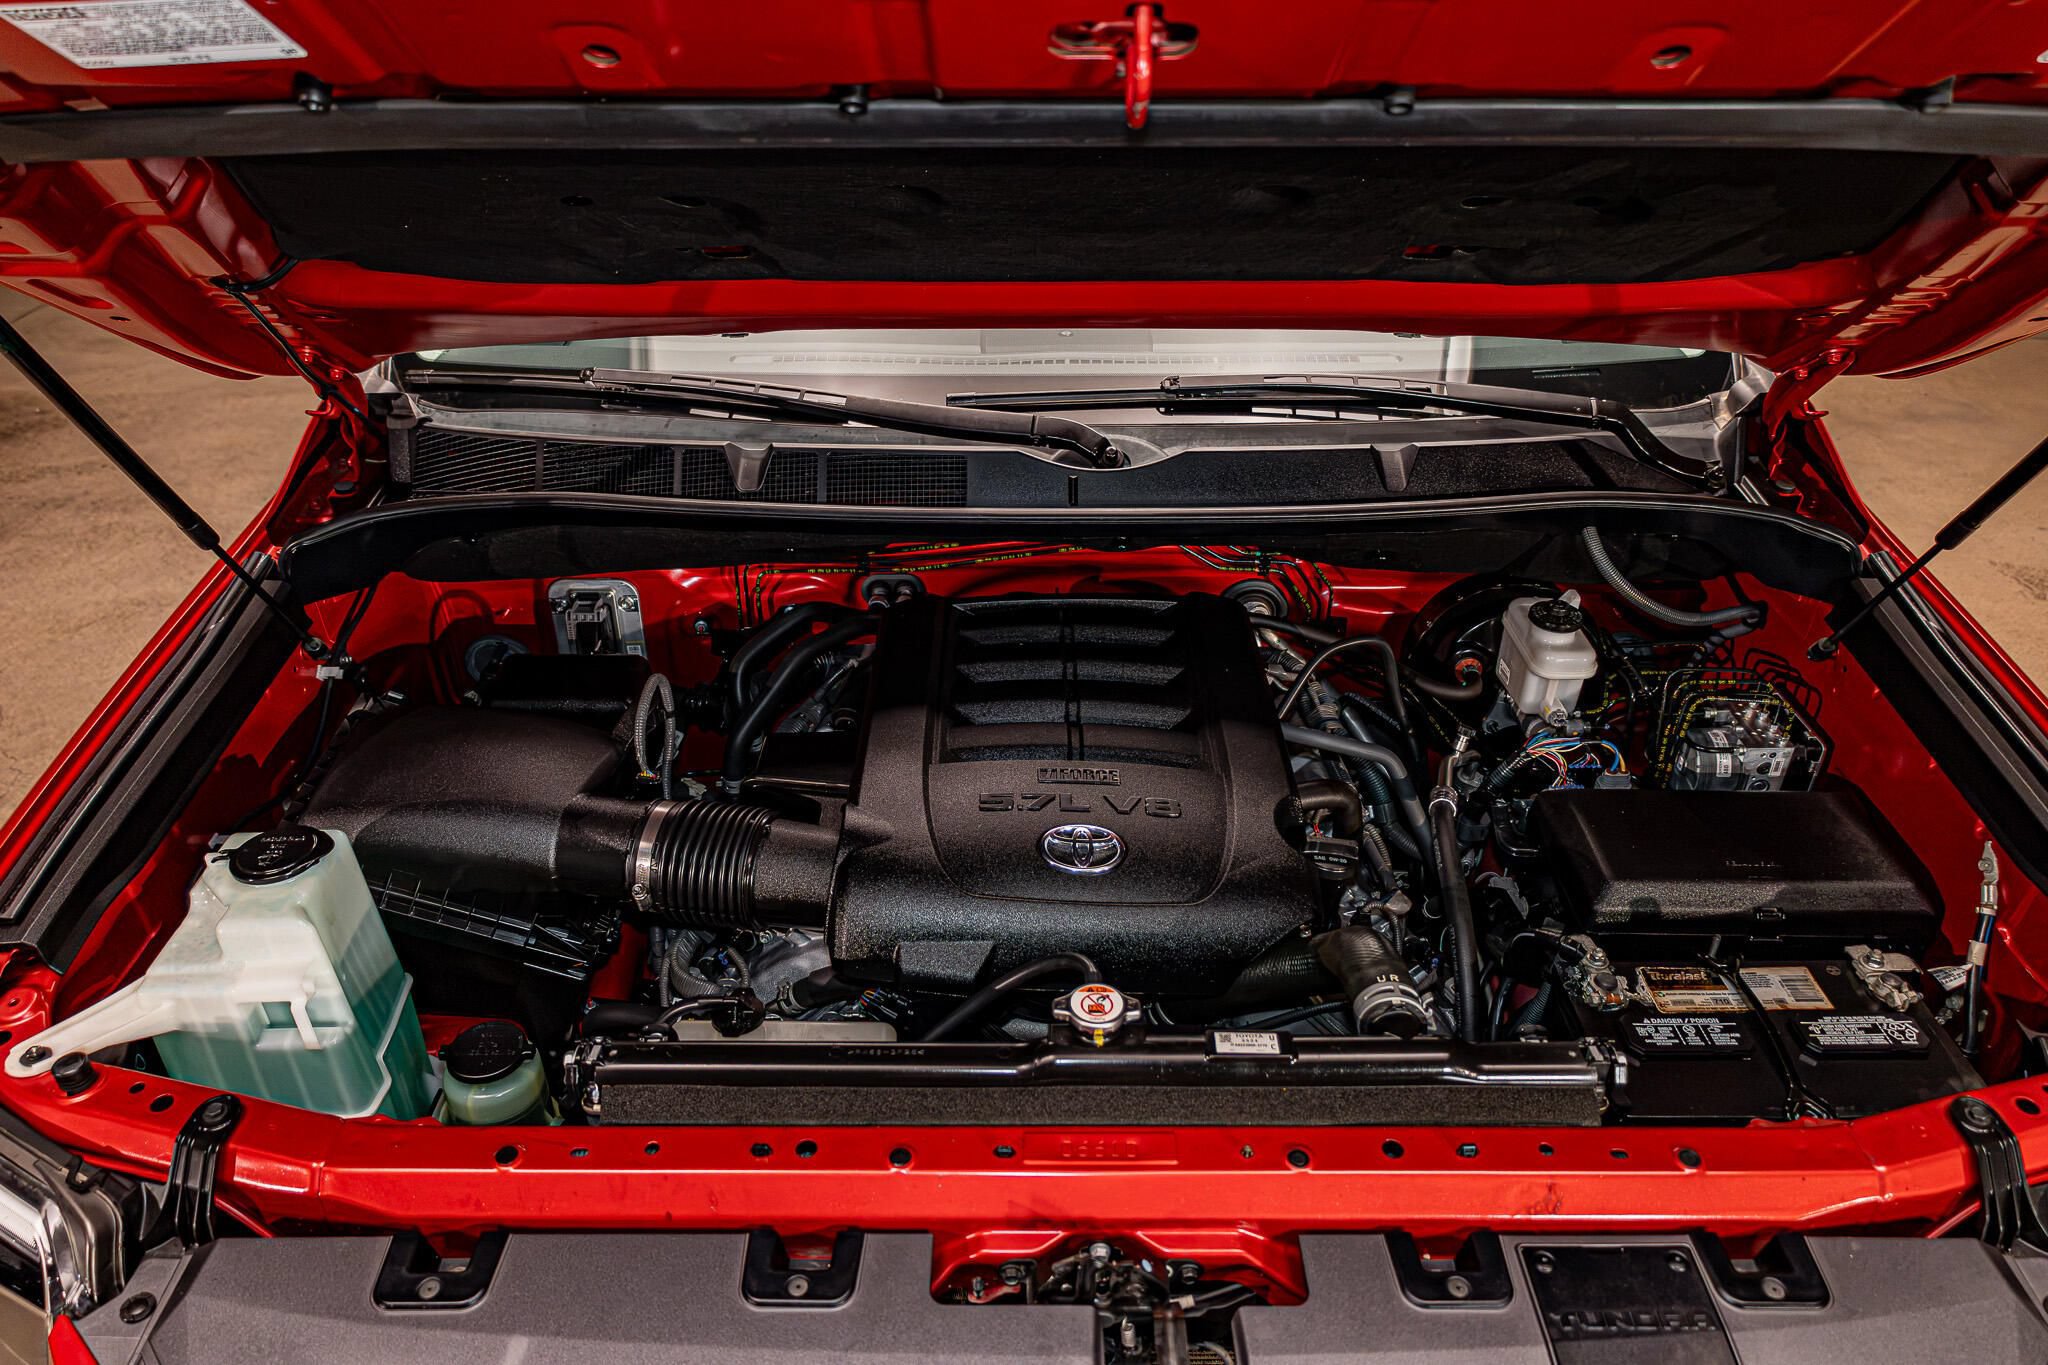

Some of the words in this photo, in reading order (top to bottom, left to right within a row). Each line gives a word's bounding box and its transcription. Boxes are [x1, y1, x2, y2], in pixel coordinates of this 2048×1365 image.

[978, 792, 1091, 813] 5.7L
[1102, 795, 1182, 818] V8
[1648, 971, 1708, 981] Duralast
[1713, 997, 1730, 1006] 710
[1548, 1310, 1718, 1332] TUNDRA
